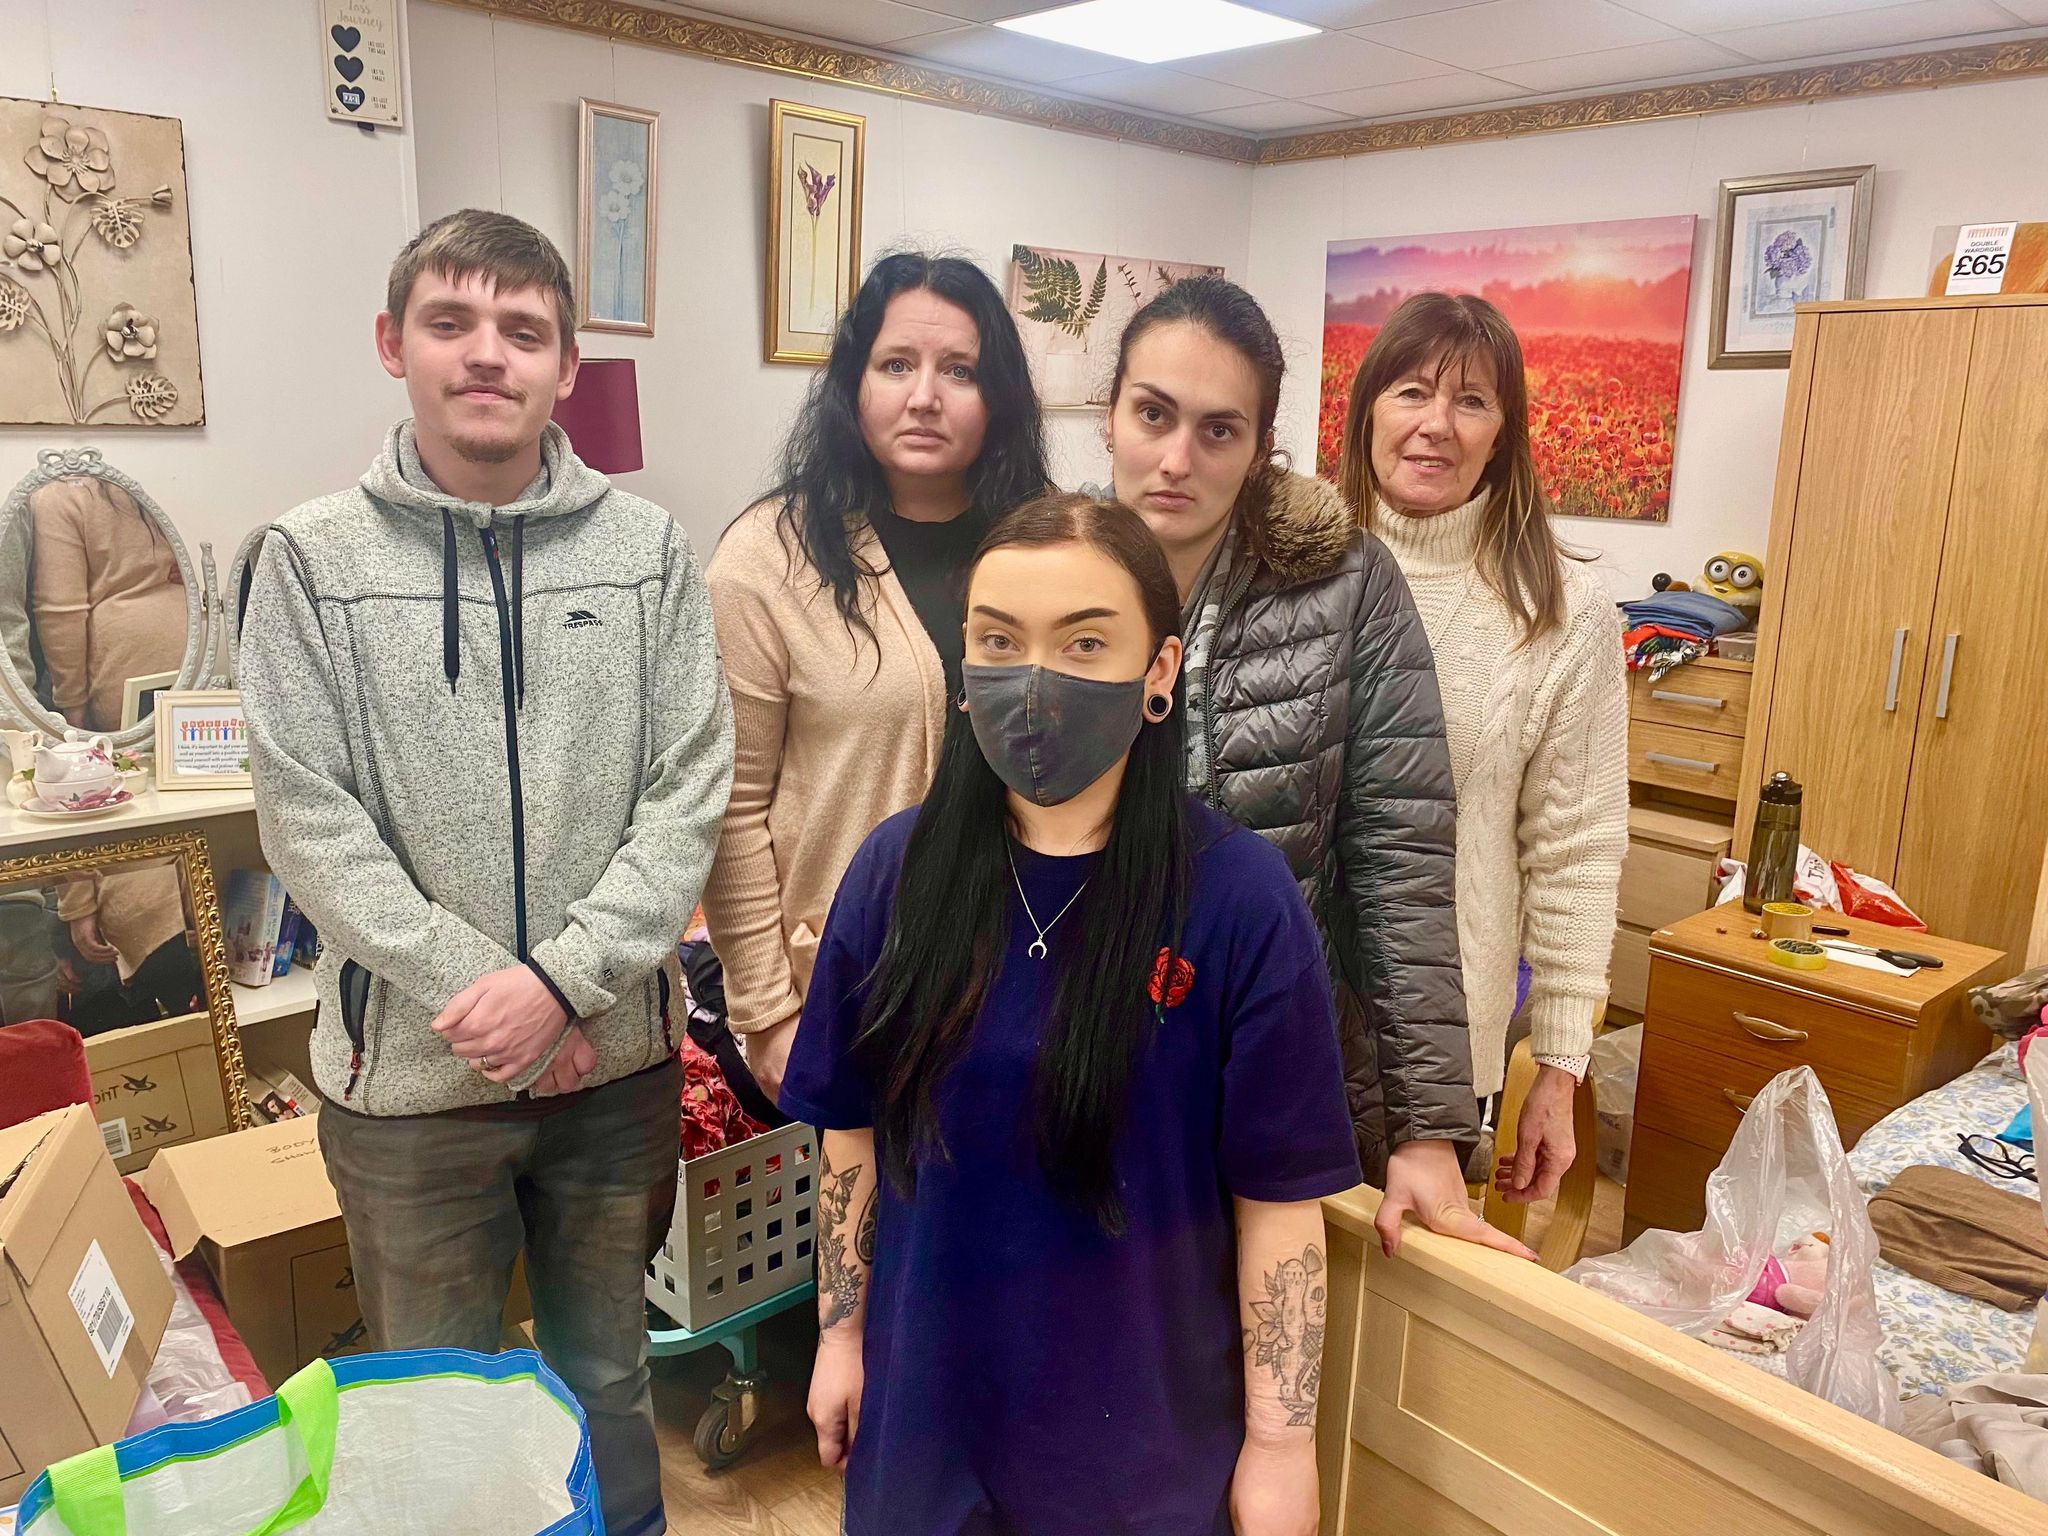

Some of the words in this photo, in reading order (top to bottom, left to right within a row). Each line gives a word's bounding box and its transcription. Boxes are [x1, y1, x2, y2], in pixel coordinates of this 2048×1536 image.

[1953, 253, 2006, 276] £65
[562, 620, 603, 630] TRESPASS
[265, 1137, 315, 1153] BODY
